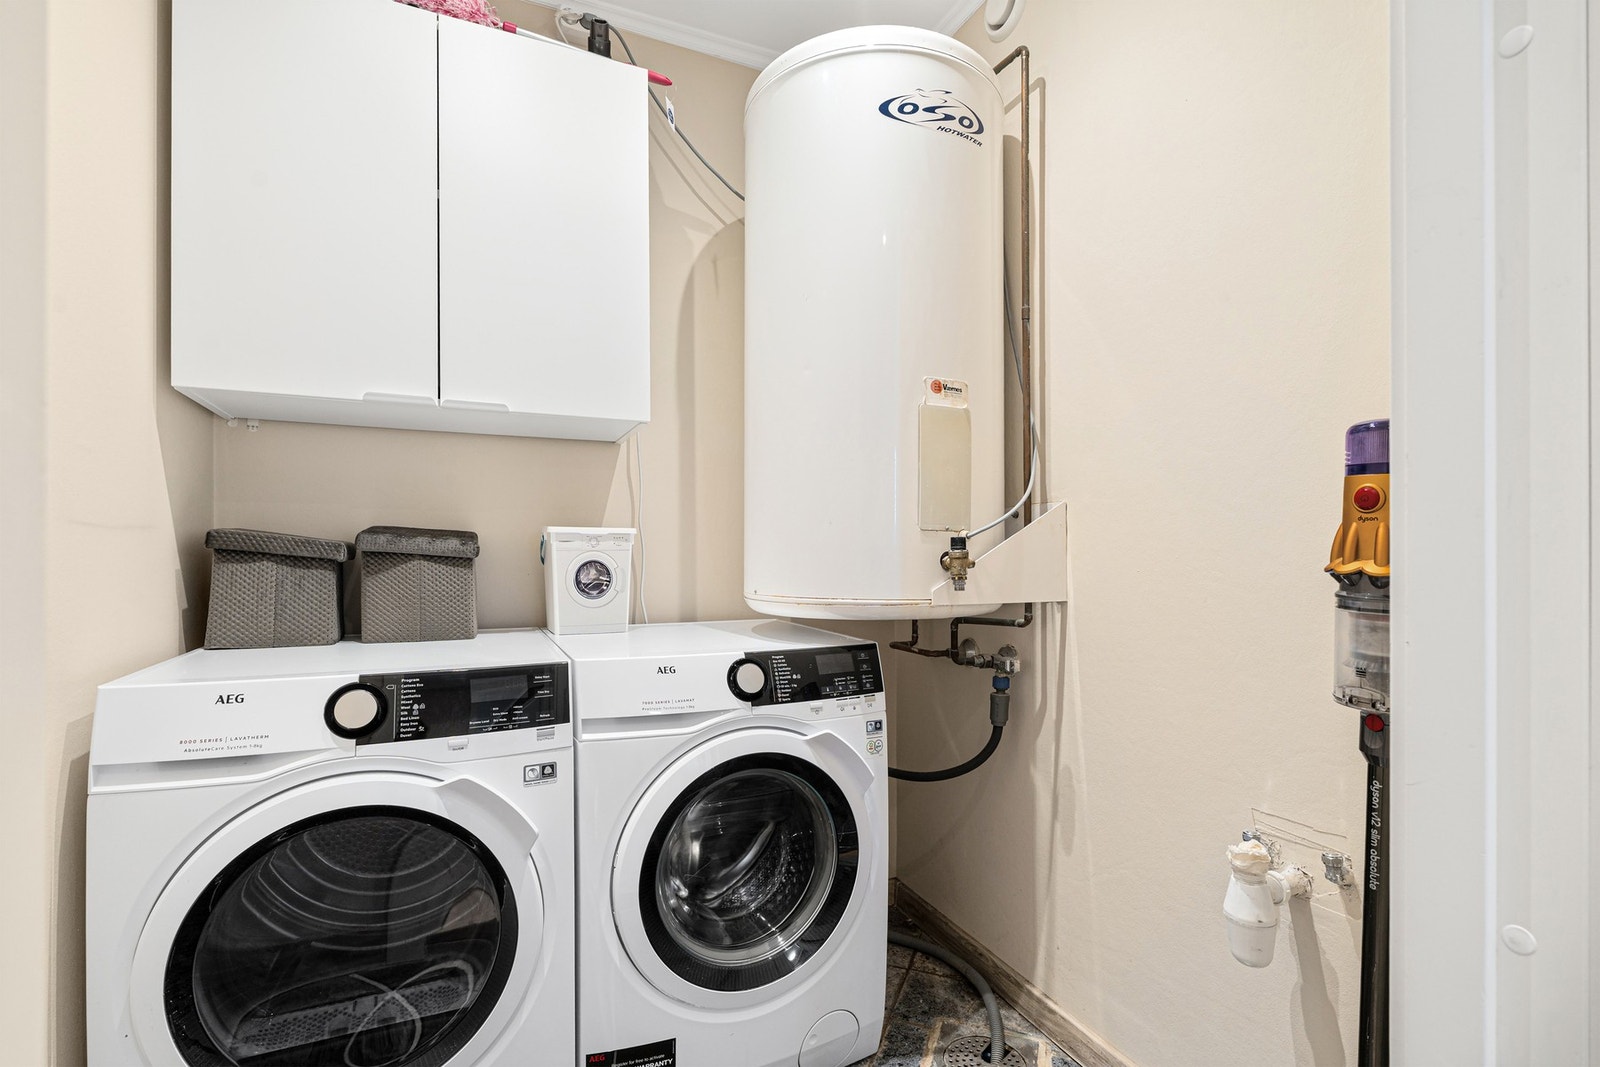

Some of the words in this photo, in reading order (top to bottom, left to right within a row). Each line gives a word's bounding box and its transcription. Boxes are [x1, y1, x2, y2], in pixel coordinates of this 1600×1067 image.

[937, 126, 982, 147] HOTWATER
[1358, 515, 1378, 523] dyson
[657, 666, 676, 674] AEG
[215, 694, 245, 705] AEG
[1370, 780, 1383, 809] dyson
[1371, 828, 1381, 846] slim
[1369, 848, 1381, 890] absolute
[589, 1054, 605, 1063] AEG
[634, 1058, 673, 1067] RRANTY
